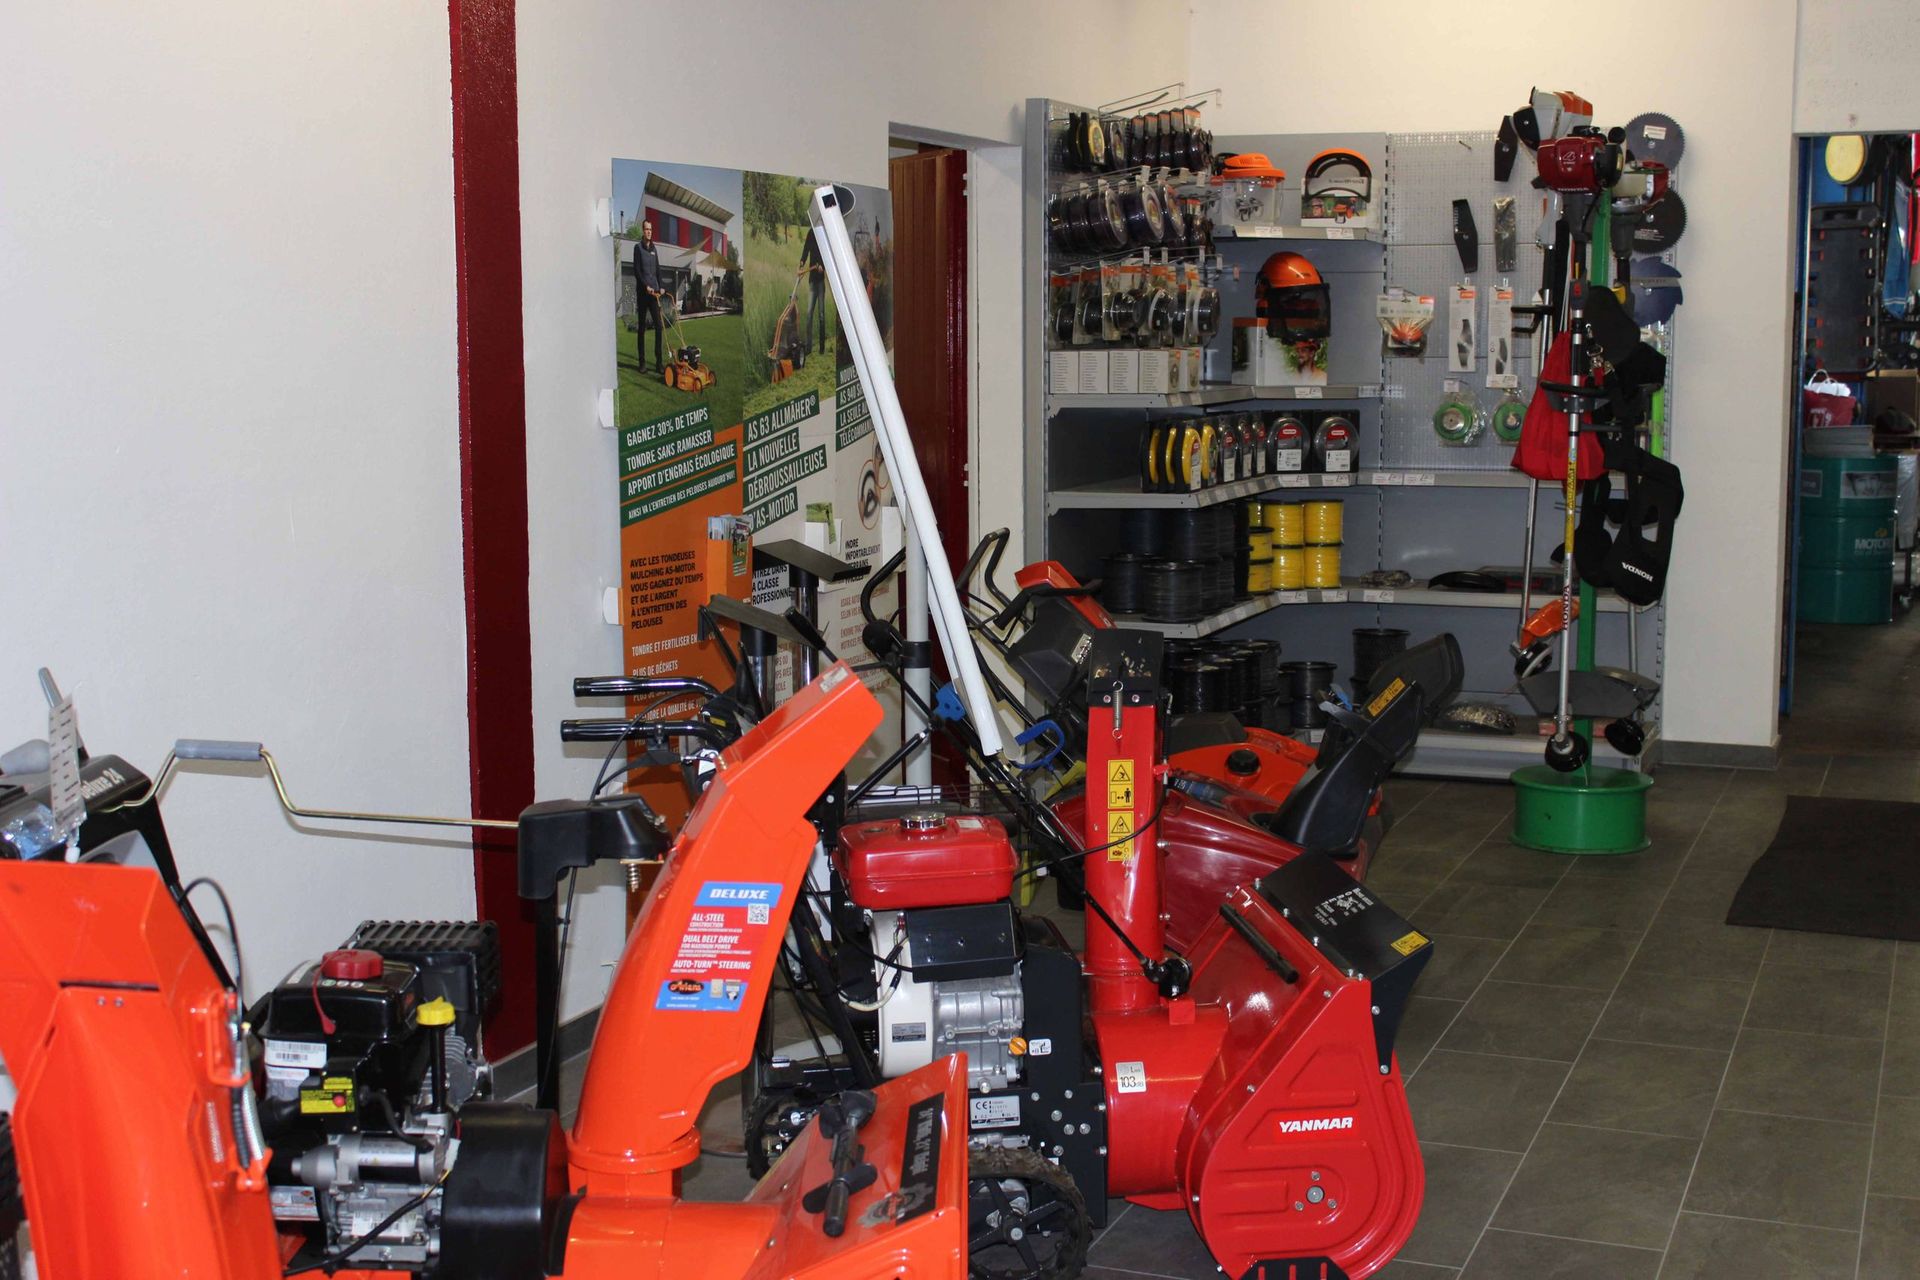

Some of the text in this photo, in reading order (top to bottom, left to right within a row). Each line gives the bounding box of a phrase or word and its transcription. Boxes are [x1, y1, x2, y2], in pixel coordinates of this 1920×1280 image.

[626, 408, 708, 446] GAGNEZ 30% DE TEMPS
[840, 412, 846, 427] LA
[748, 420, 757, 442] AS
[760, 416, 769, 432] 63
[626, 430, 712, 471] TONDRE SANS RAMASSER
[748, 432, 798, 472] LA NOUVELLE
[628, 444, 735, 496] APPORT D'ENGRAIS ÉCOLOGIQUE
[748, 450, 824, 501] DÉBROUSSAILLEUSE
[628, 507, 641, 520] AINSI
[642, 504, 648, 514] VA
[649, 493, 676, 513] L'ENTRETIEN
[677, 490, 685, 501] DES
[686, 482, 707, 497] PELOUSES
[630, 551, 695, 568] AVEC LES TONDEUSES
[630, 563, 696, 580] MULCHING AS-MOTOR
[1622, 562, 1653, 582] HONDA
[631, 573, 704, 593] VOUS GAGNEZ DU TEMPS
[758, 577, 779, 591] CLASSE
[631, 589, 678, 605] ET DE L'ARGENT
[637, 602, 674, 616] L'ENTRETIEN
[675, 600, 687, 609] DES
[631, 616, 663, 630] PELOUSES
[632, 643, 653, 656] TONDRE
[654, 642, 661, 652] ET
[661, 636, 690, 650] FERTILISER
[647, 665, 655, 676] DE
[656, 660, 678, 674] DÉCHETS
[660, 708, 666, 718] LA
[667, 702, 687, 715] QUALITÉ
[710, 888, 770, 900] DELUXE
[691, 913, 725, 922] ALL-STEEL
[683, 935, 739, 944] DUAL BELT DRIVE
[718, 960, 751, 970] STEERING
[1120, 1076, 1136, 1088] 103
[1279, 1117, 1353, 1133] YANMAR
